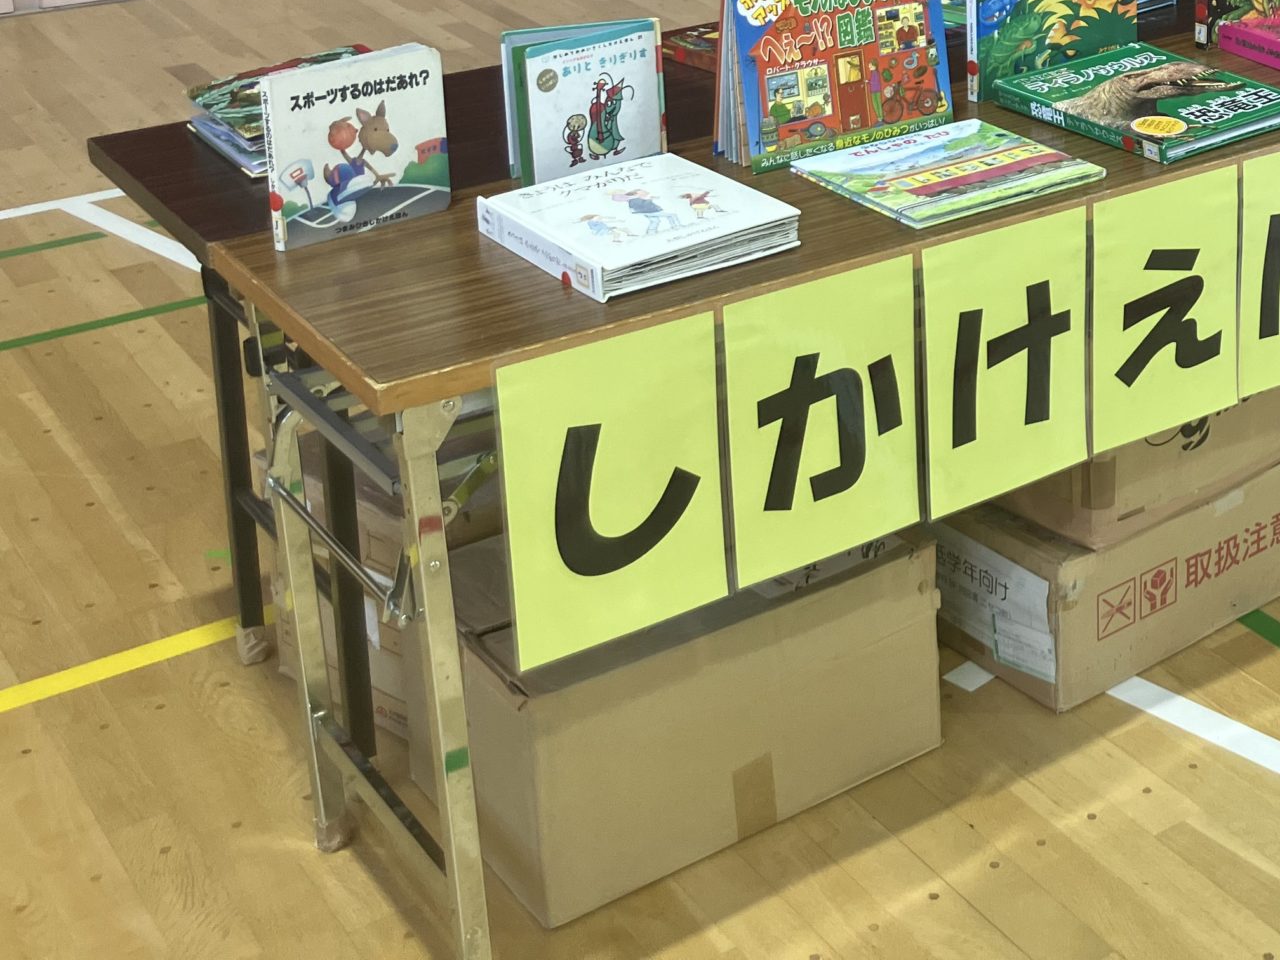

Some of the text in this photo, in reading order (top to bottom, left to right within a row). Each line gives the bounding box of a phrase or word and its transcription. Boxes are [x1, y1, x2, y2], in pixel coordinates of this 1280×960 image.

[835, 6, 877, 50] 図鑑
[766, 58, 826, 76] ロバート・クラウサー
[1023, 51, 1167, 94] ティラノサウルス
[290, 69, 430, 112] スポーツするのはだあれ?
